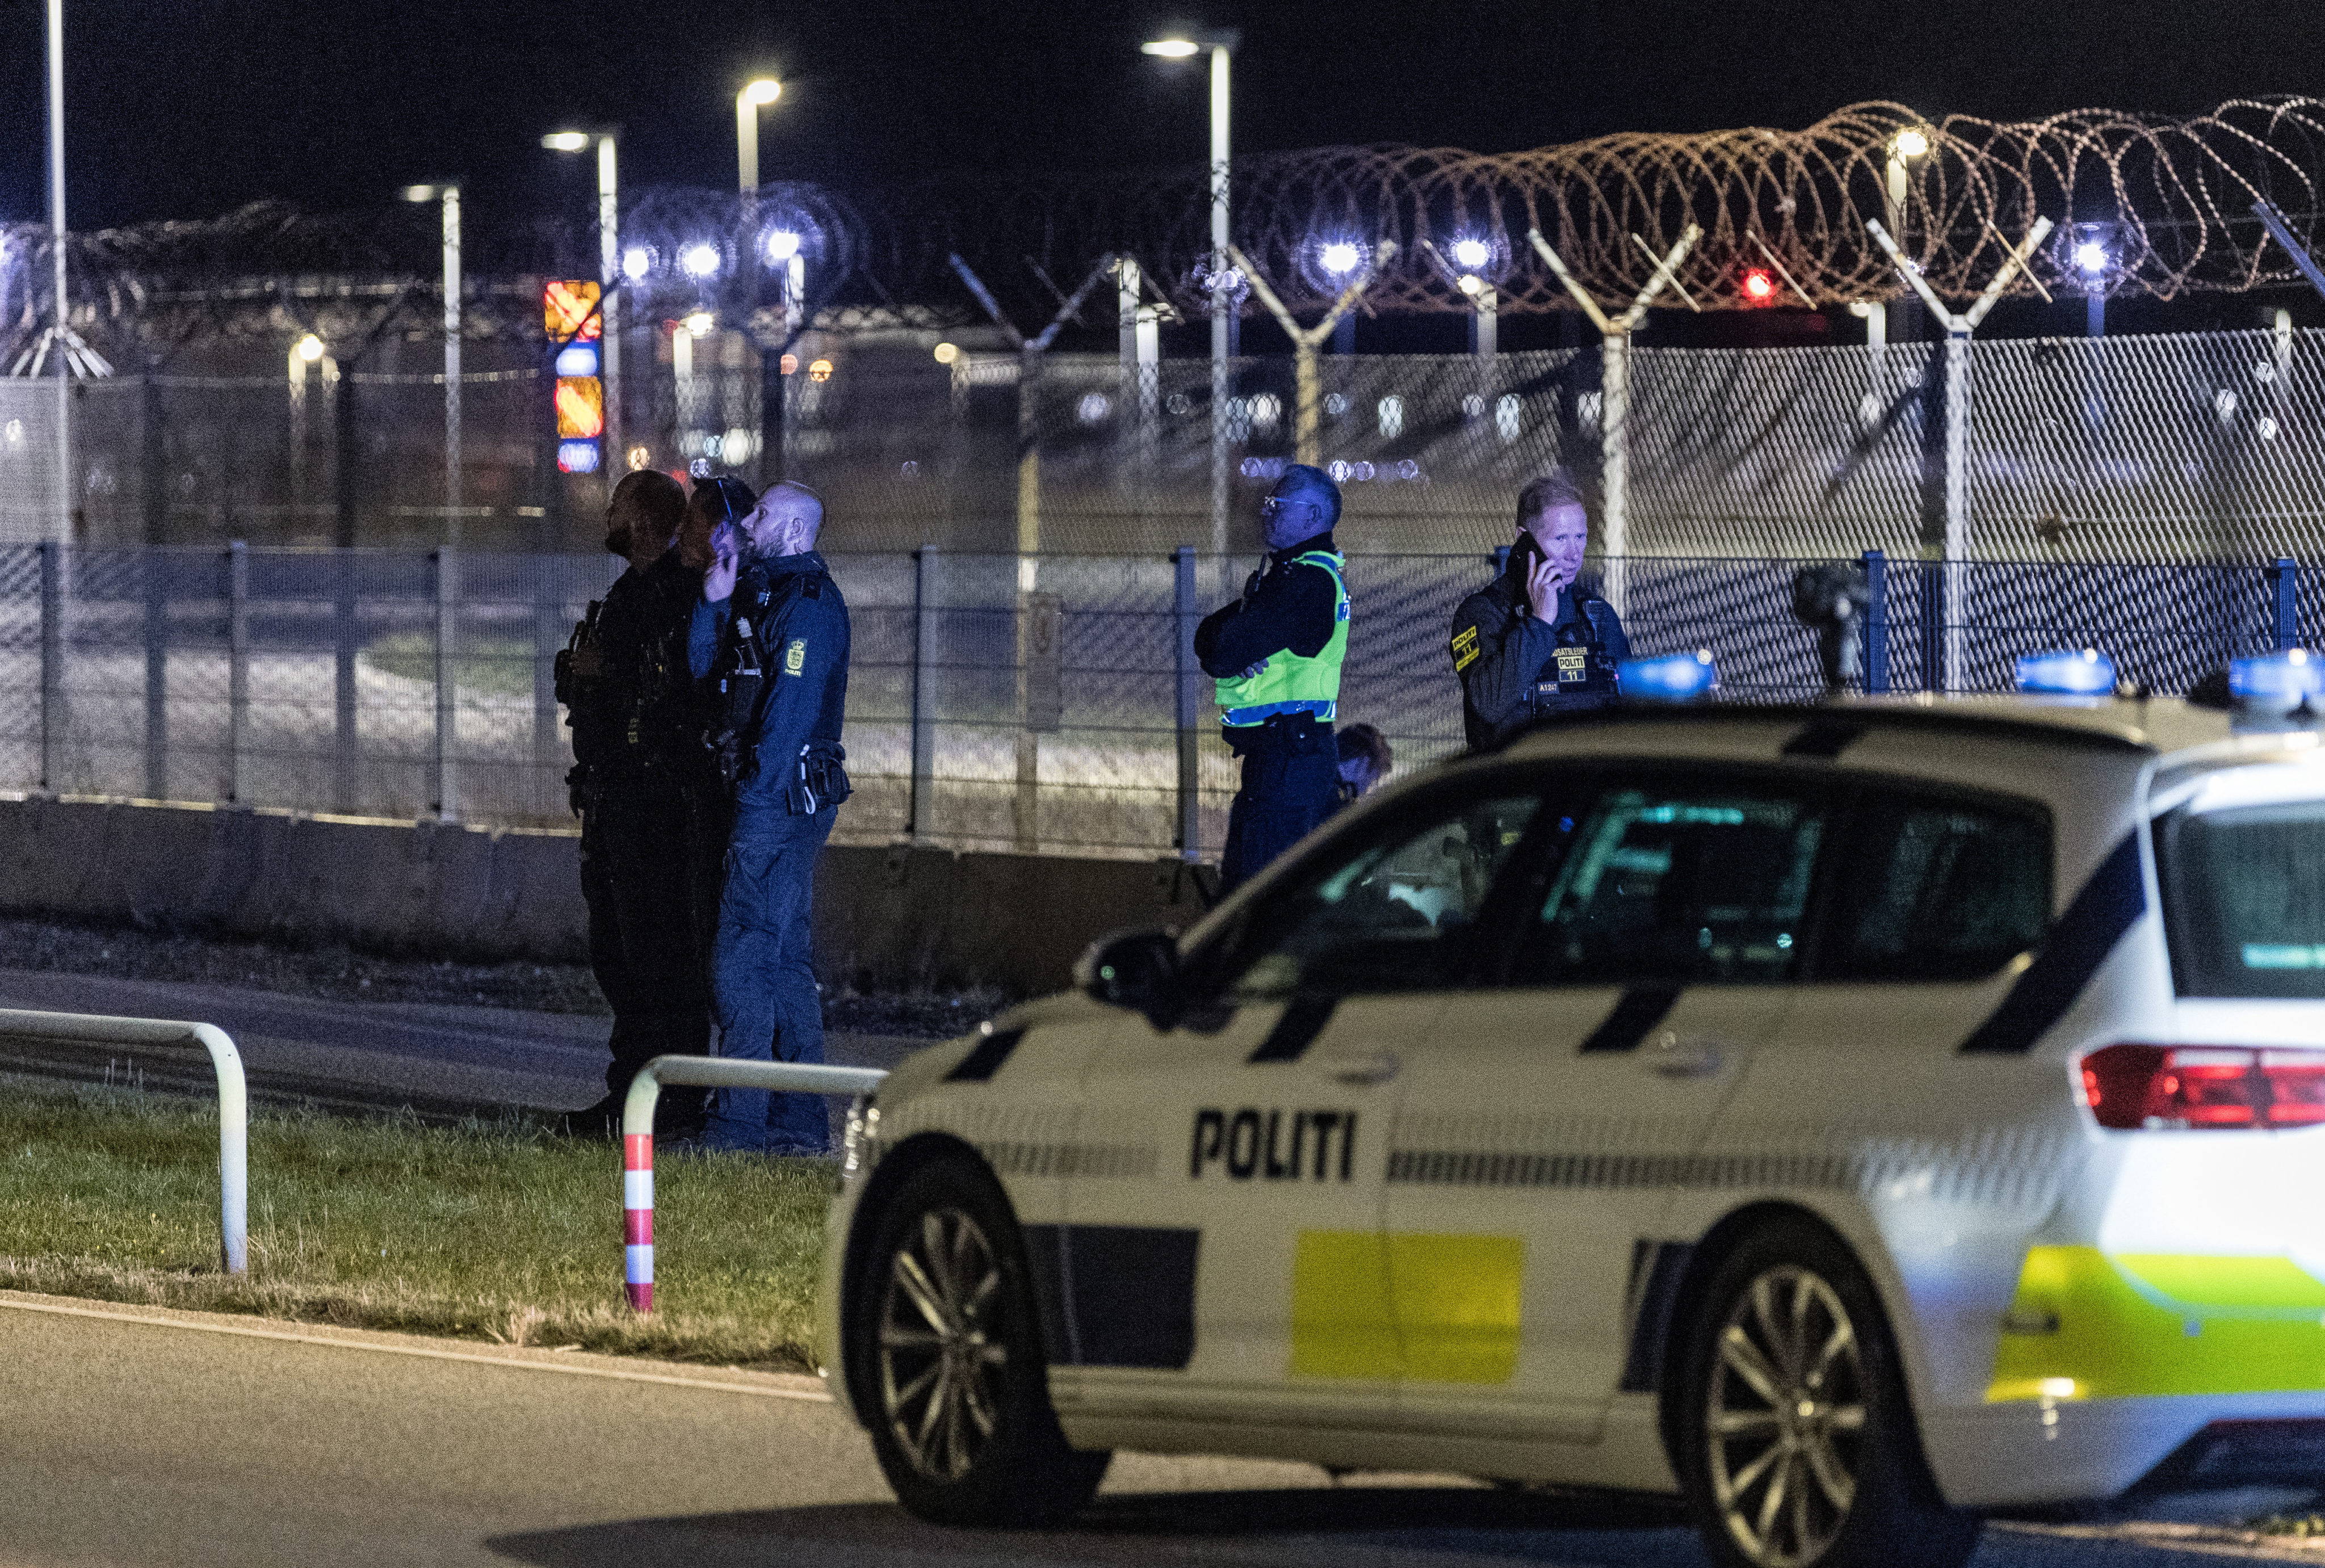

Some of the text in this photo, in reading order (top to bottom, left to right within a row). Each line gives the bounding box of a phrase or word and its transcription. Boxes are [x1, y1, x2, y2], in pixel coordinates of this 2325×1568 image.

[1454, 628, 1475, 647] POLITI
[1462, 644, 1471, 655] 11
[1559, 658, 1583, 667] POLITI
[1567, 671, 1577, 680] 11
[1191, 1109, 1355, 1182] POLITI
